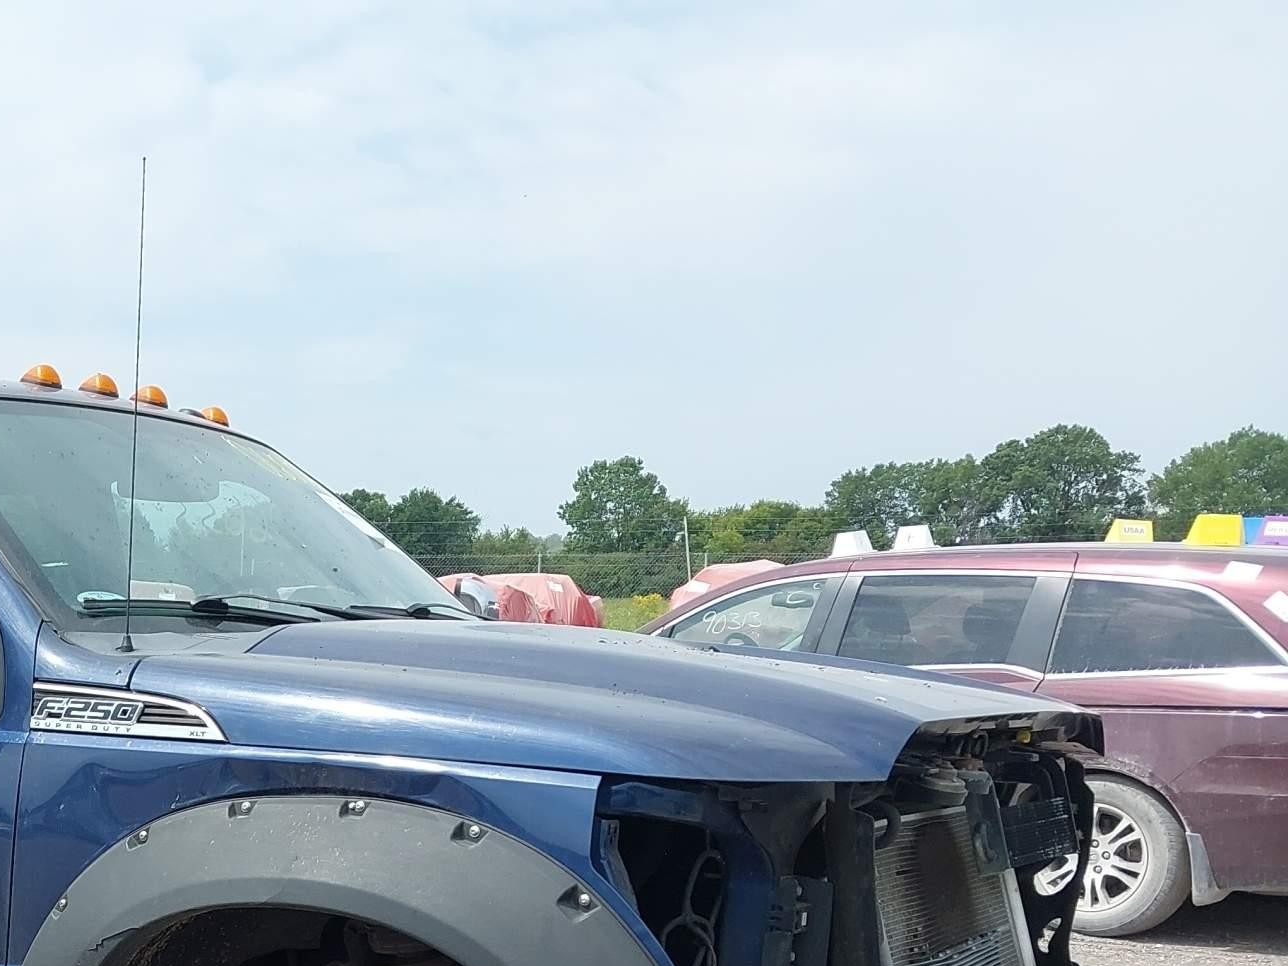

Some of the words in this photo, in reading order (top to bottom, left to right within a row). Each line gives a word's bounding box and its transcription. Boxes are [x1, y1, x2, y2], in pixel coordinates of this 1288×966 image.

[1123, 527, 1145, 535] USAA
[702, 611, 761, 634] 90313
[33, 698, 142, 724] F-250
[34, 721, 83, 730] SUPER
[91, 725, 132, 733] DUTY
